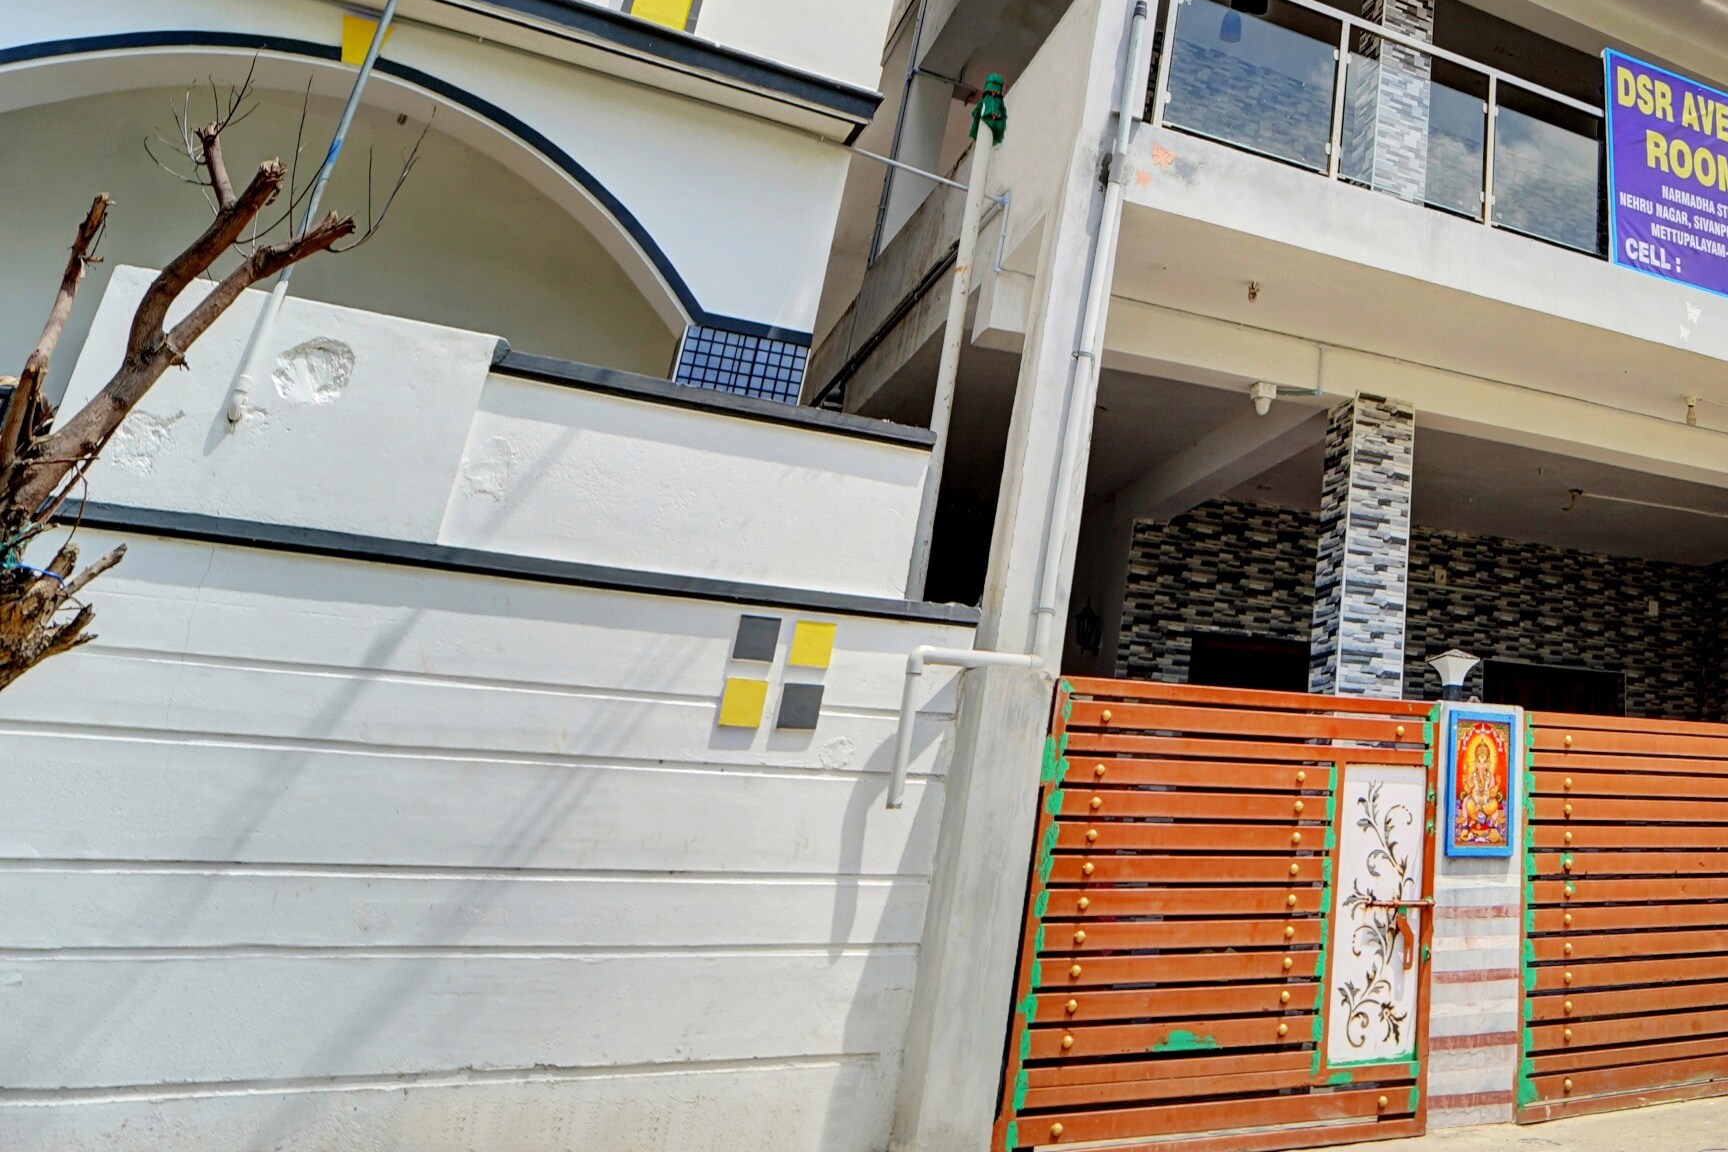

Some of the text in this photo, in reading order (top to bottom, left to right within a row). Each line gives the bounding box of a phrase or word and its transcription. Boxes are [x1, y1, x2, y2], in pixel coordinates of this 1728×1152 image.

[1616, 65, 1675, 123] DSR
[1619, 191, 1653, 215] NEHRU
[1655, 203, 1692, 229] NAGAR,
[1661, 185, 1715, 215] NARMADHA
